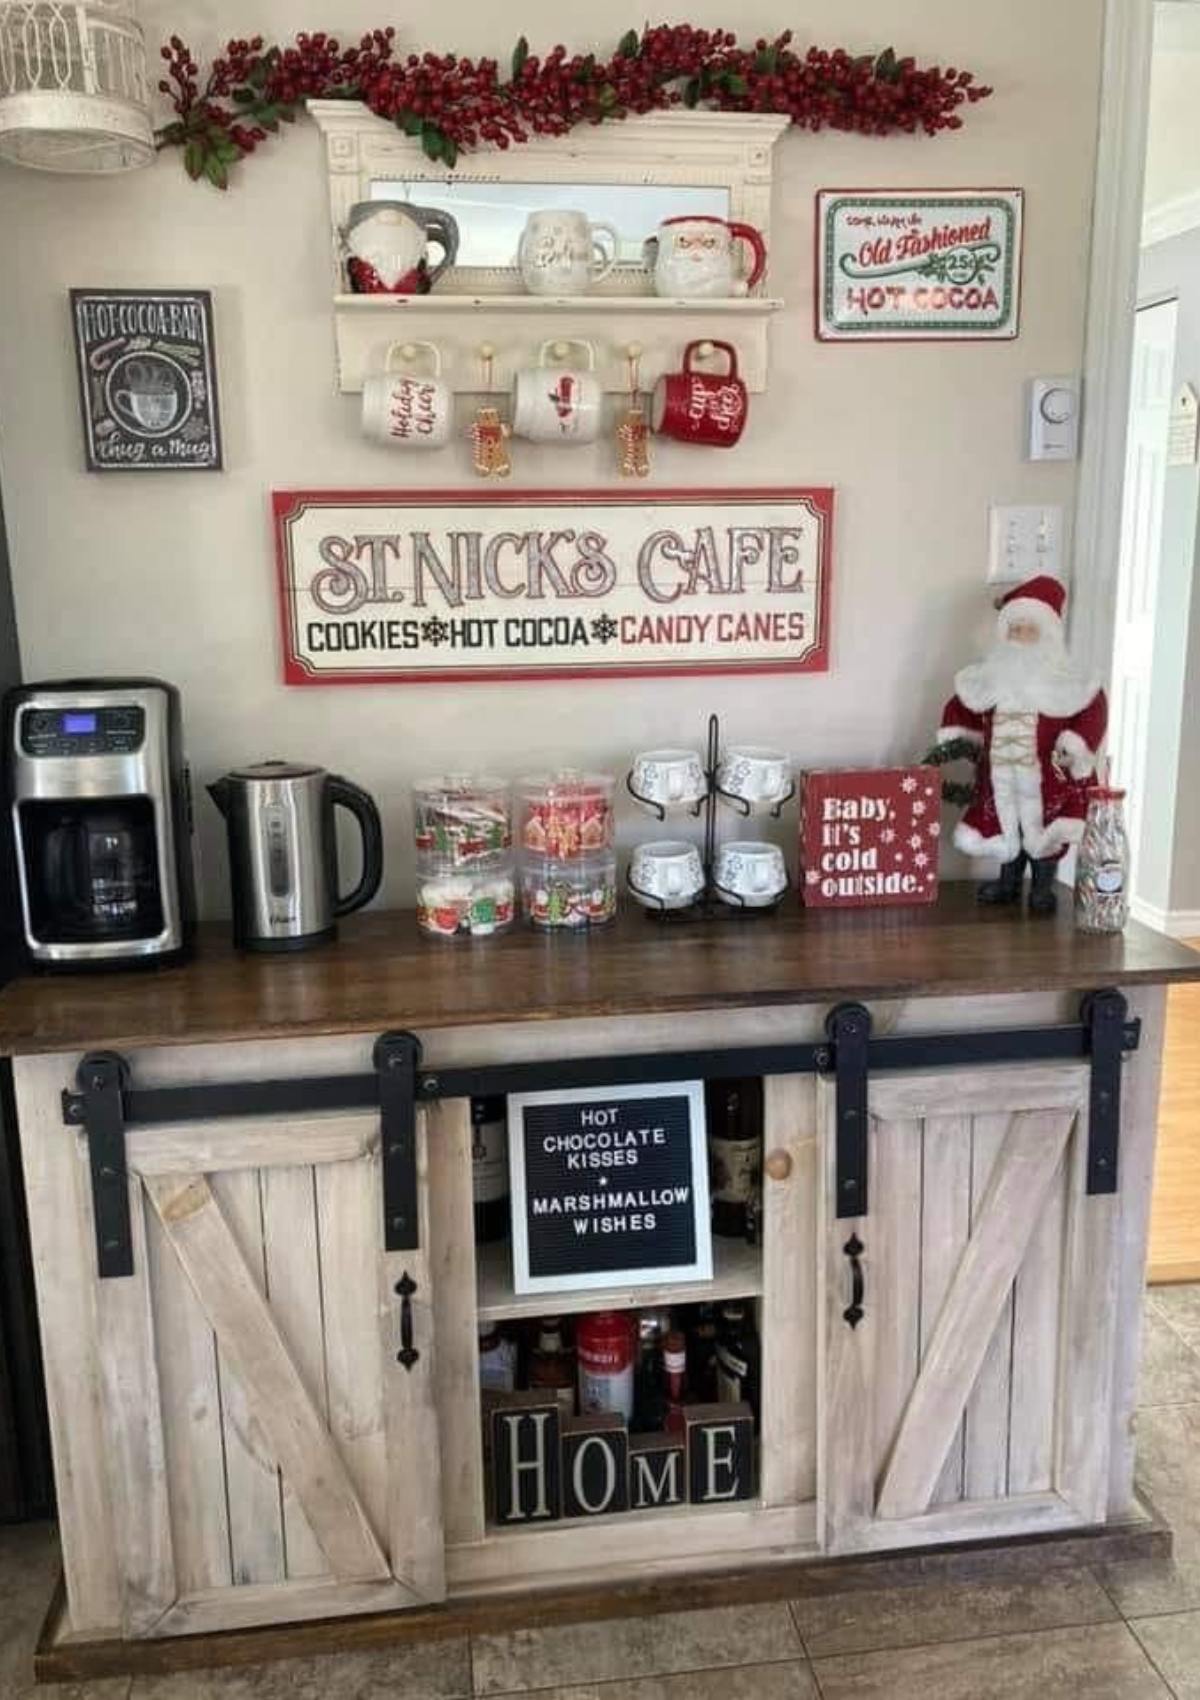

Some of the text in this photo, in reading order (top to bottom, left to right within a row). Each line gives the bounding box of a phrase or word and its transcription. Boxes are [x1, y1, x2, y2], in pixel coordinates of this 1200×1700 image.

[858, 215, 992, 268] Old Fashioned
[847, 286, 1000, 316] HOT COCOA
[637, 525, 805, 604] CAFE
[307, 612, 804, 651] COOKIES HOT COCOA CANDY CANES
[821, 847, 877, 872] cold
[581, 1108, 619, 1127] HOT
[543, 1128, 667, 1153] CHOCOLATE
[567, 1149, 638, 1170] KISSES
[532, 1187, 690, 1215] MARSHMALLOW
[573, 1213, 657, 1235] WISHES
